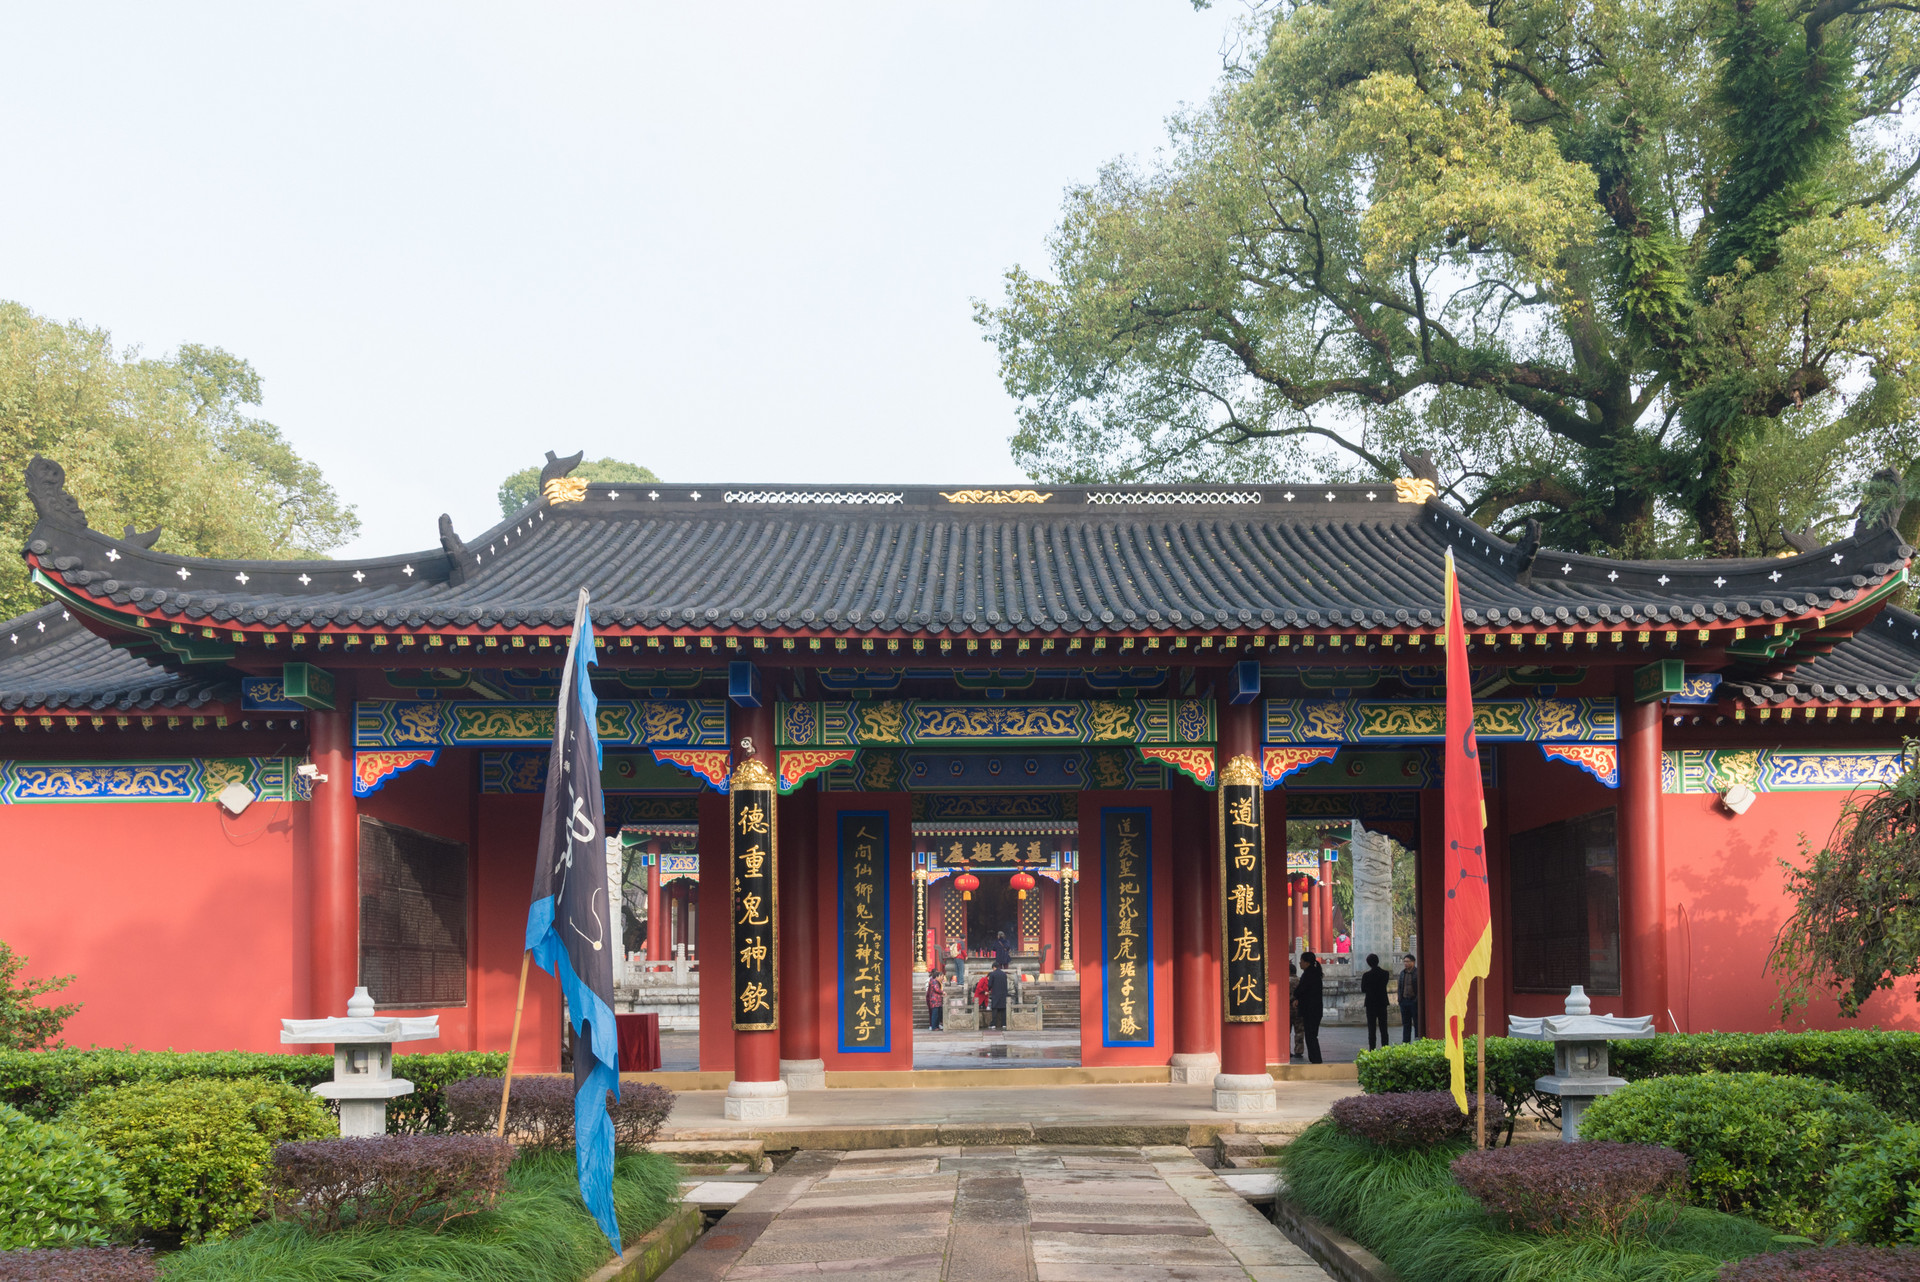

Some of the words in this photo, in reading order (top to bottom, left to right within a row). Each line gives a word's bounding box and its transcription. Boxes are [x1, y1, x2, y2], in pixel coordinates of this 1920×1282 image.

[1228, 797, 1263, 1007] 道高龍虎伏
